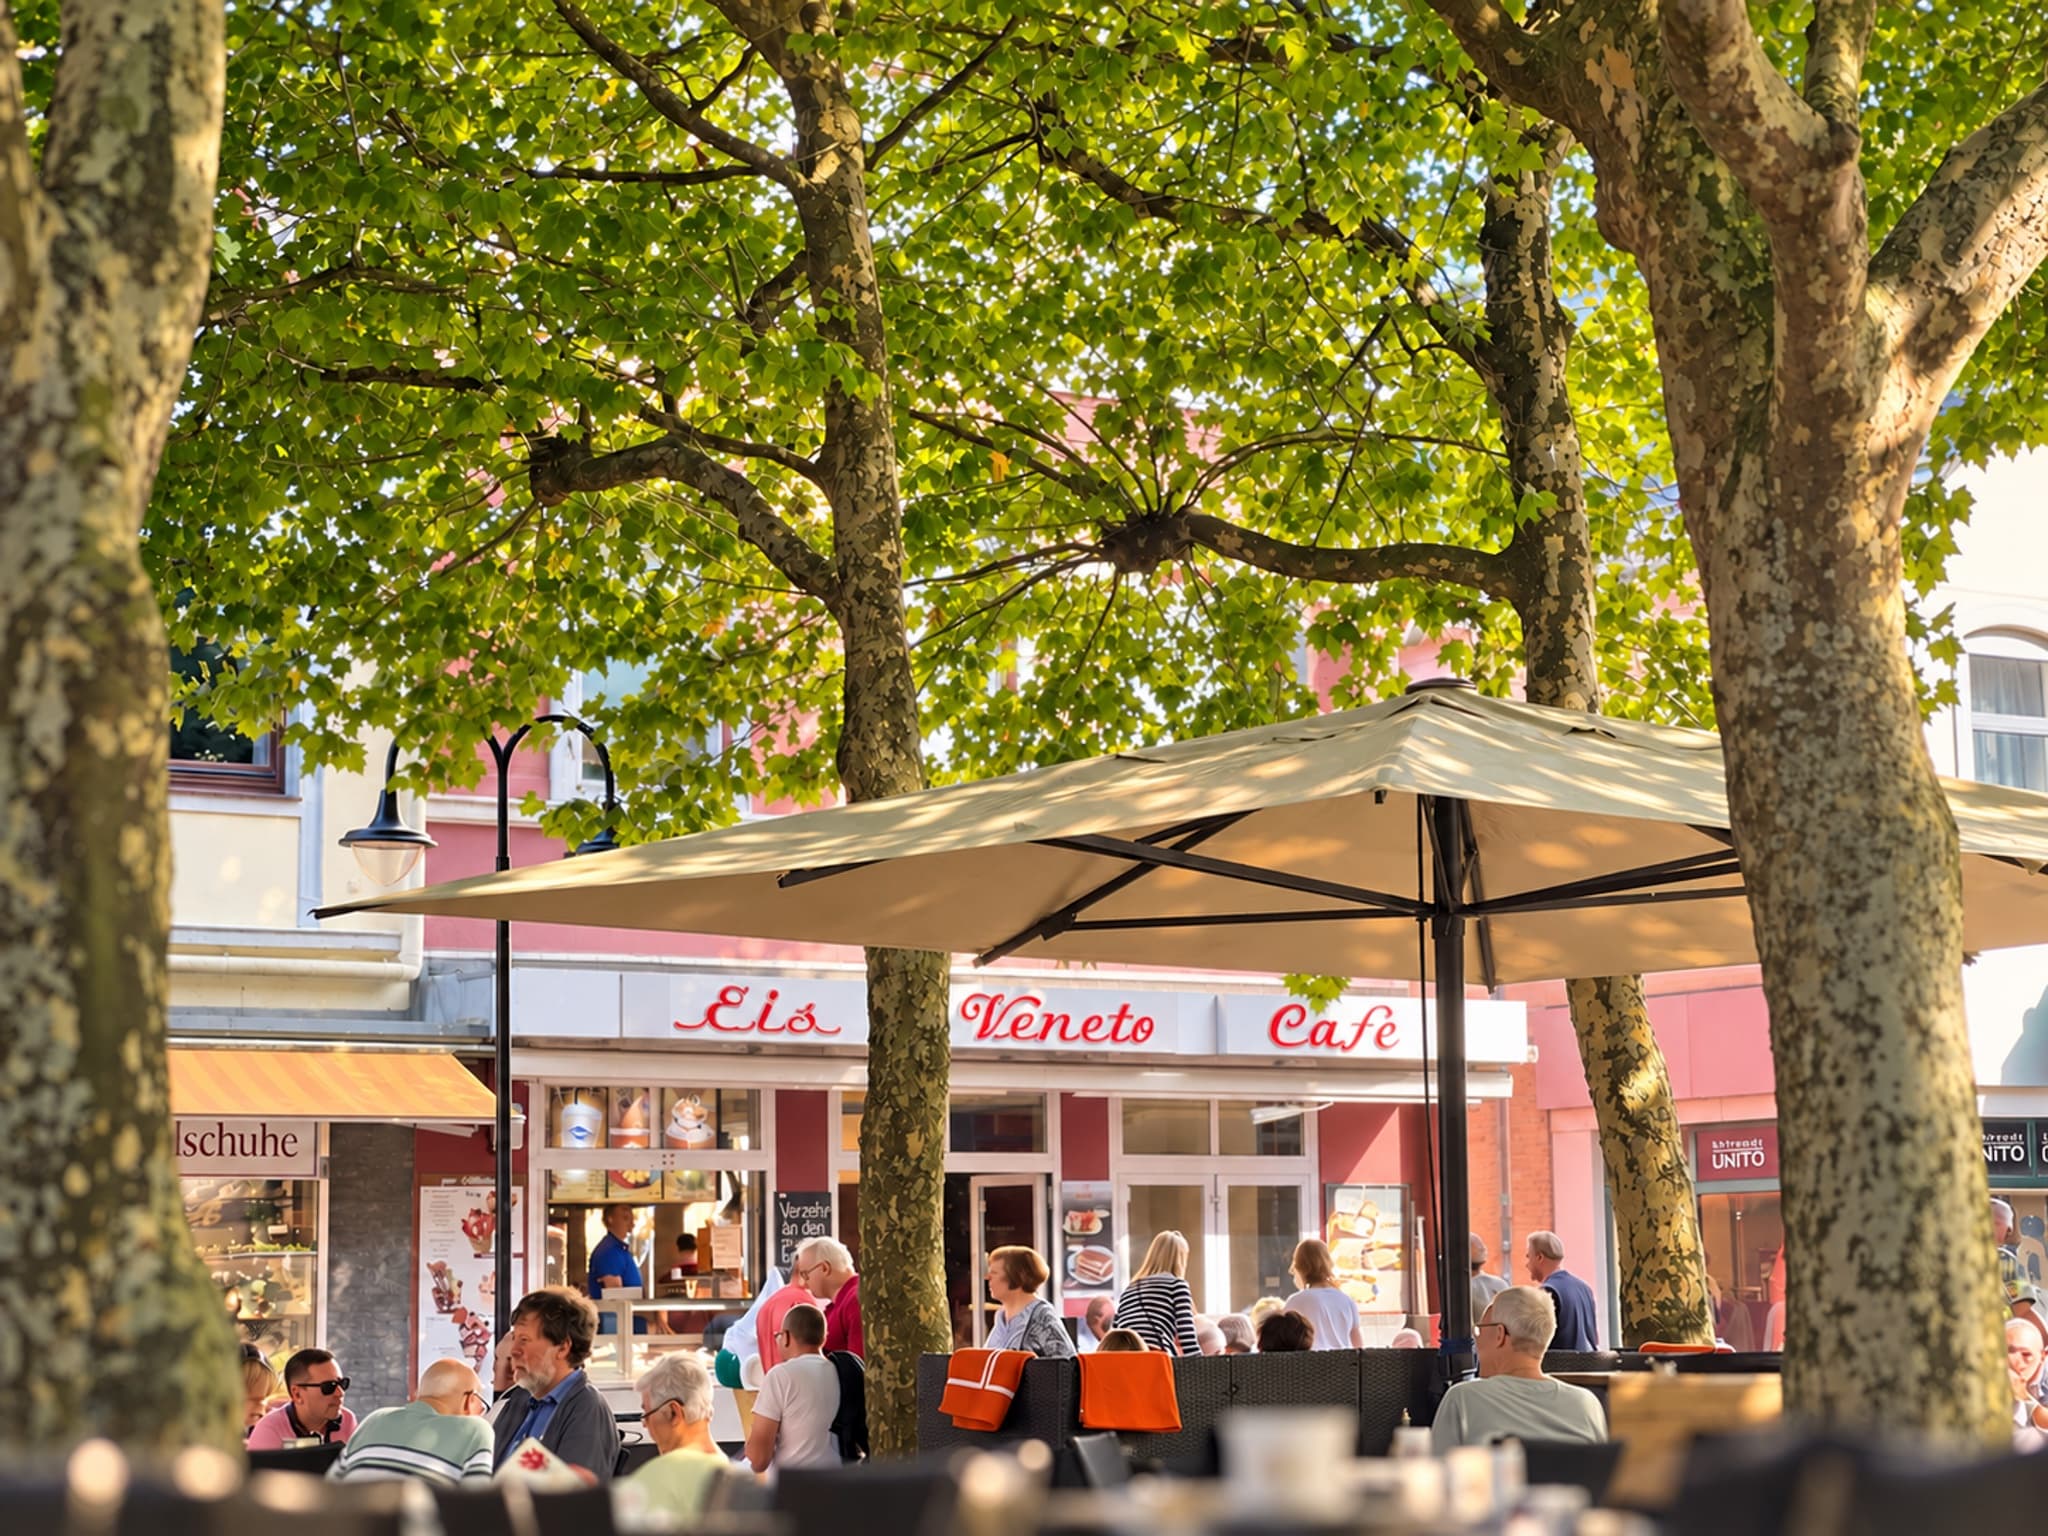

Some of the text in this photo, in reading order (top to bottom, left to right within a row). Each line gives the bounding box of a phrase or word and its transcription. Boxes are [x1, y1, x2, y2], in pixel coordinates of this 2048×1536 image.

[673, 985, 842, 1034] Eis
[960, 993, 1155, 1044] Veneto
[1712, 1150, 1765, 1169] UNITO
[779, 1201, 831, 1219] Verzehr
[801, 1220, 826, 1236] den
